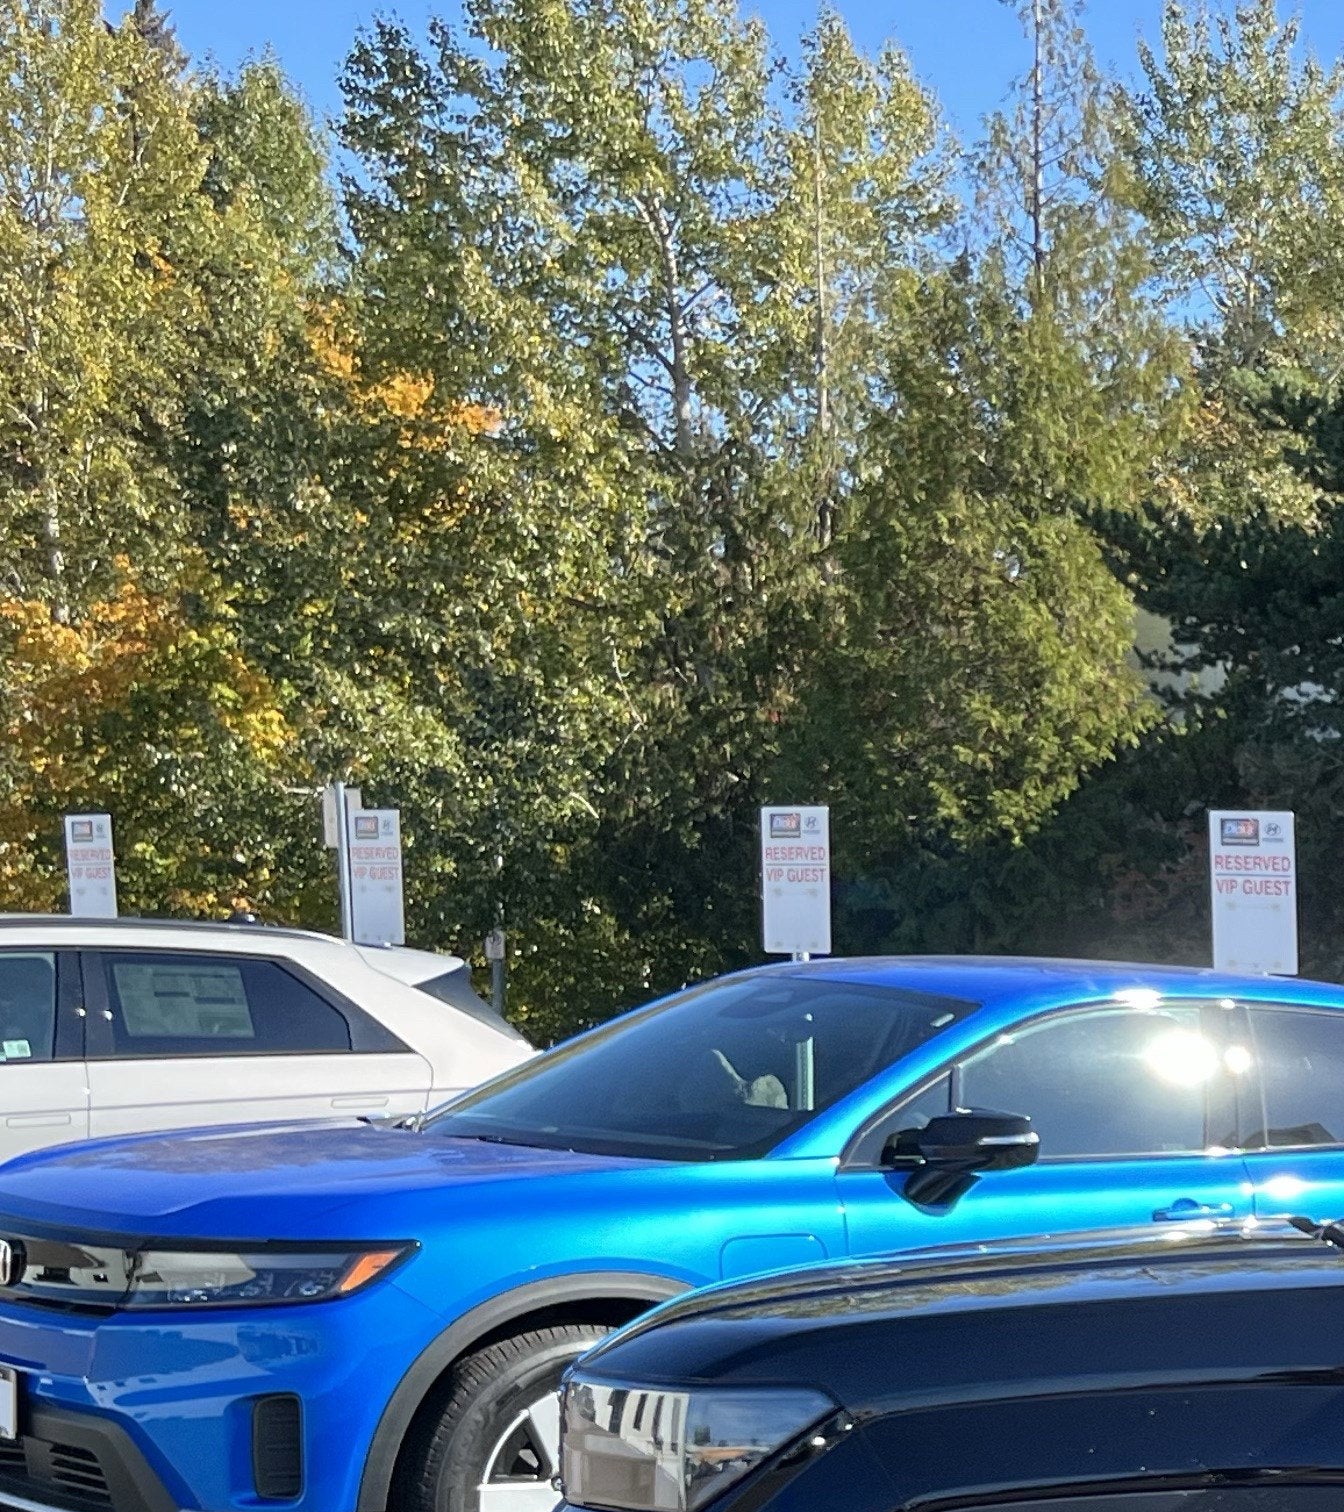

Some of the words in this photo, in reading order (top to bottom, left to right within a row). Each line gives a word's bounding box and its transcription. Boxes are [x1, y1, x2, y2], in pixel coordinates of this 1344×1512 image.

[765, 847, 826, 861] RESERVED
[1214, 854, 1291, 872] RESERVED
[766, 868, 784, 882] VIP
[787, 868, 826, 883] GUEST
[1216, 879, 1238, 894] VIP
[1242, 879, 1292, 896] GUEST
